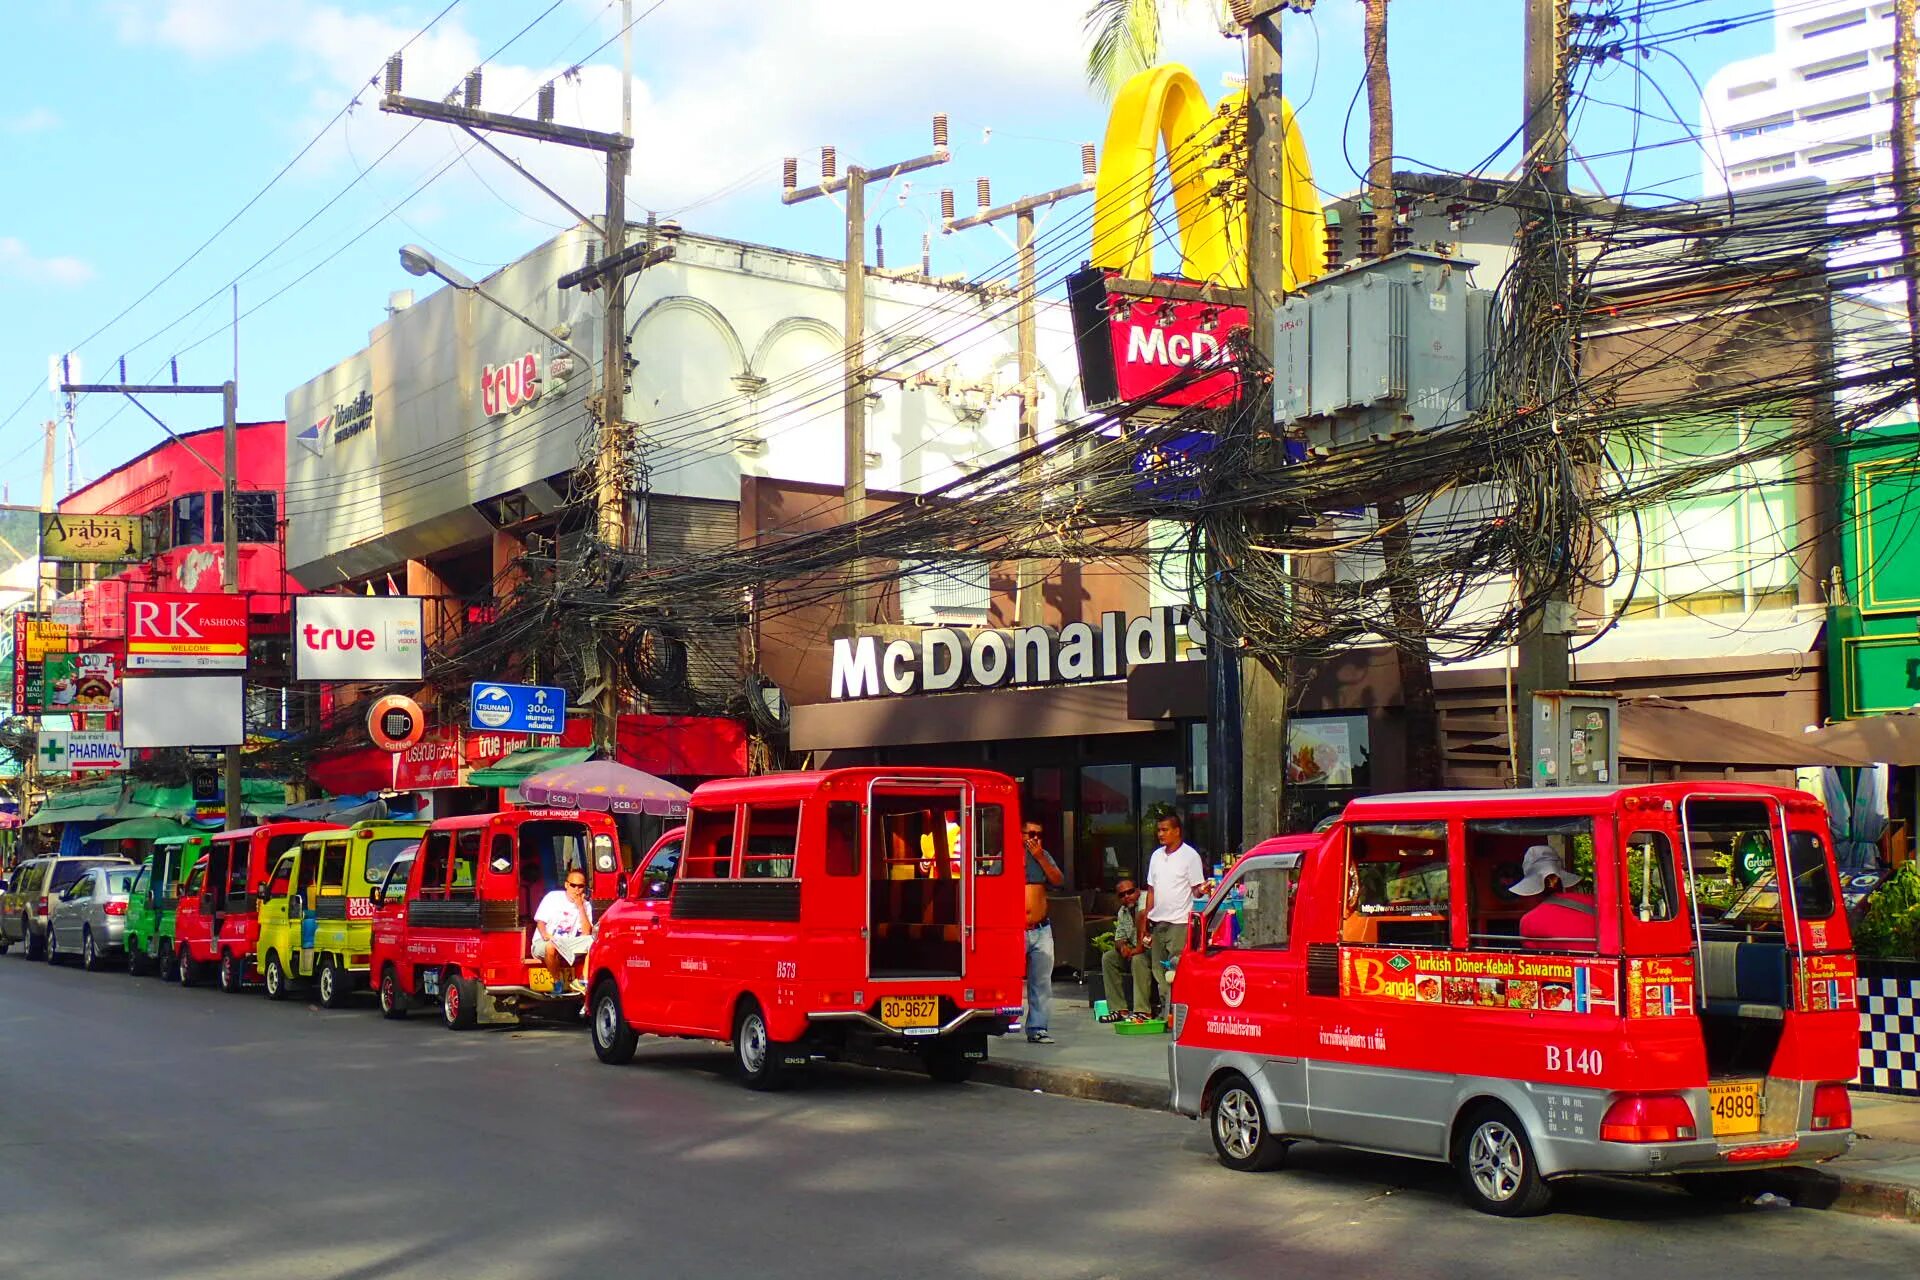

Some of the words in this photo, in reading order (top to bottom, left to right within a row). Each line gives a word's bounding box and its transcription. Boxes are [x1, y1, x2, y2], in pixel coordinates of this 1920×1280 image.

[481, 353, 537, 417] true
[44, 513, 122, 542] Arabia
[130, 601, 204, 638] RK
[199, 618, 246, 627] FASHIONS
[170, 644, 211, 652] WELCOME
[303, 624, 375, 650] true
[830, 604, 1207, 699] McDonald's
[15, 674, 25, 713] FOOD
[479, 703, 510, 711] TSUNAMI
[527, 704, 555, 714] 300m
[69, 743, 127, 758] PHARMACY
[479, 735, 500, 758] true
[552, 795, 567, 803] SCB
[776, 961, 796, 978] B573
[1354, 957, 1415, 999] Bangla
[1415, 955, 1452, 972] Turkish
[1455, 957, 1515, 974] Döner-Kebab
[1518, 959, 1572, 978] Sawarma
[884, 1001, 936, 1018] 30-9627
[1544, 1045, 1603, 1076] B140
